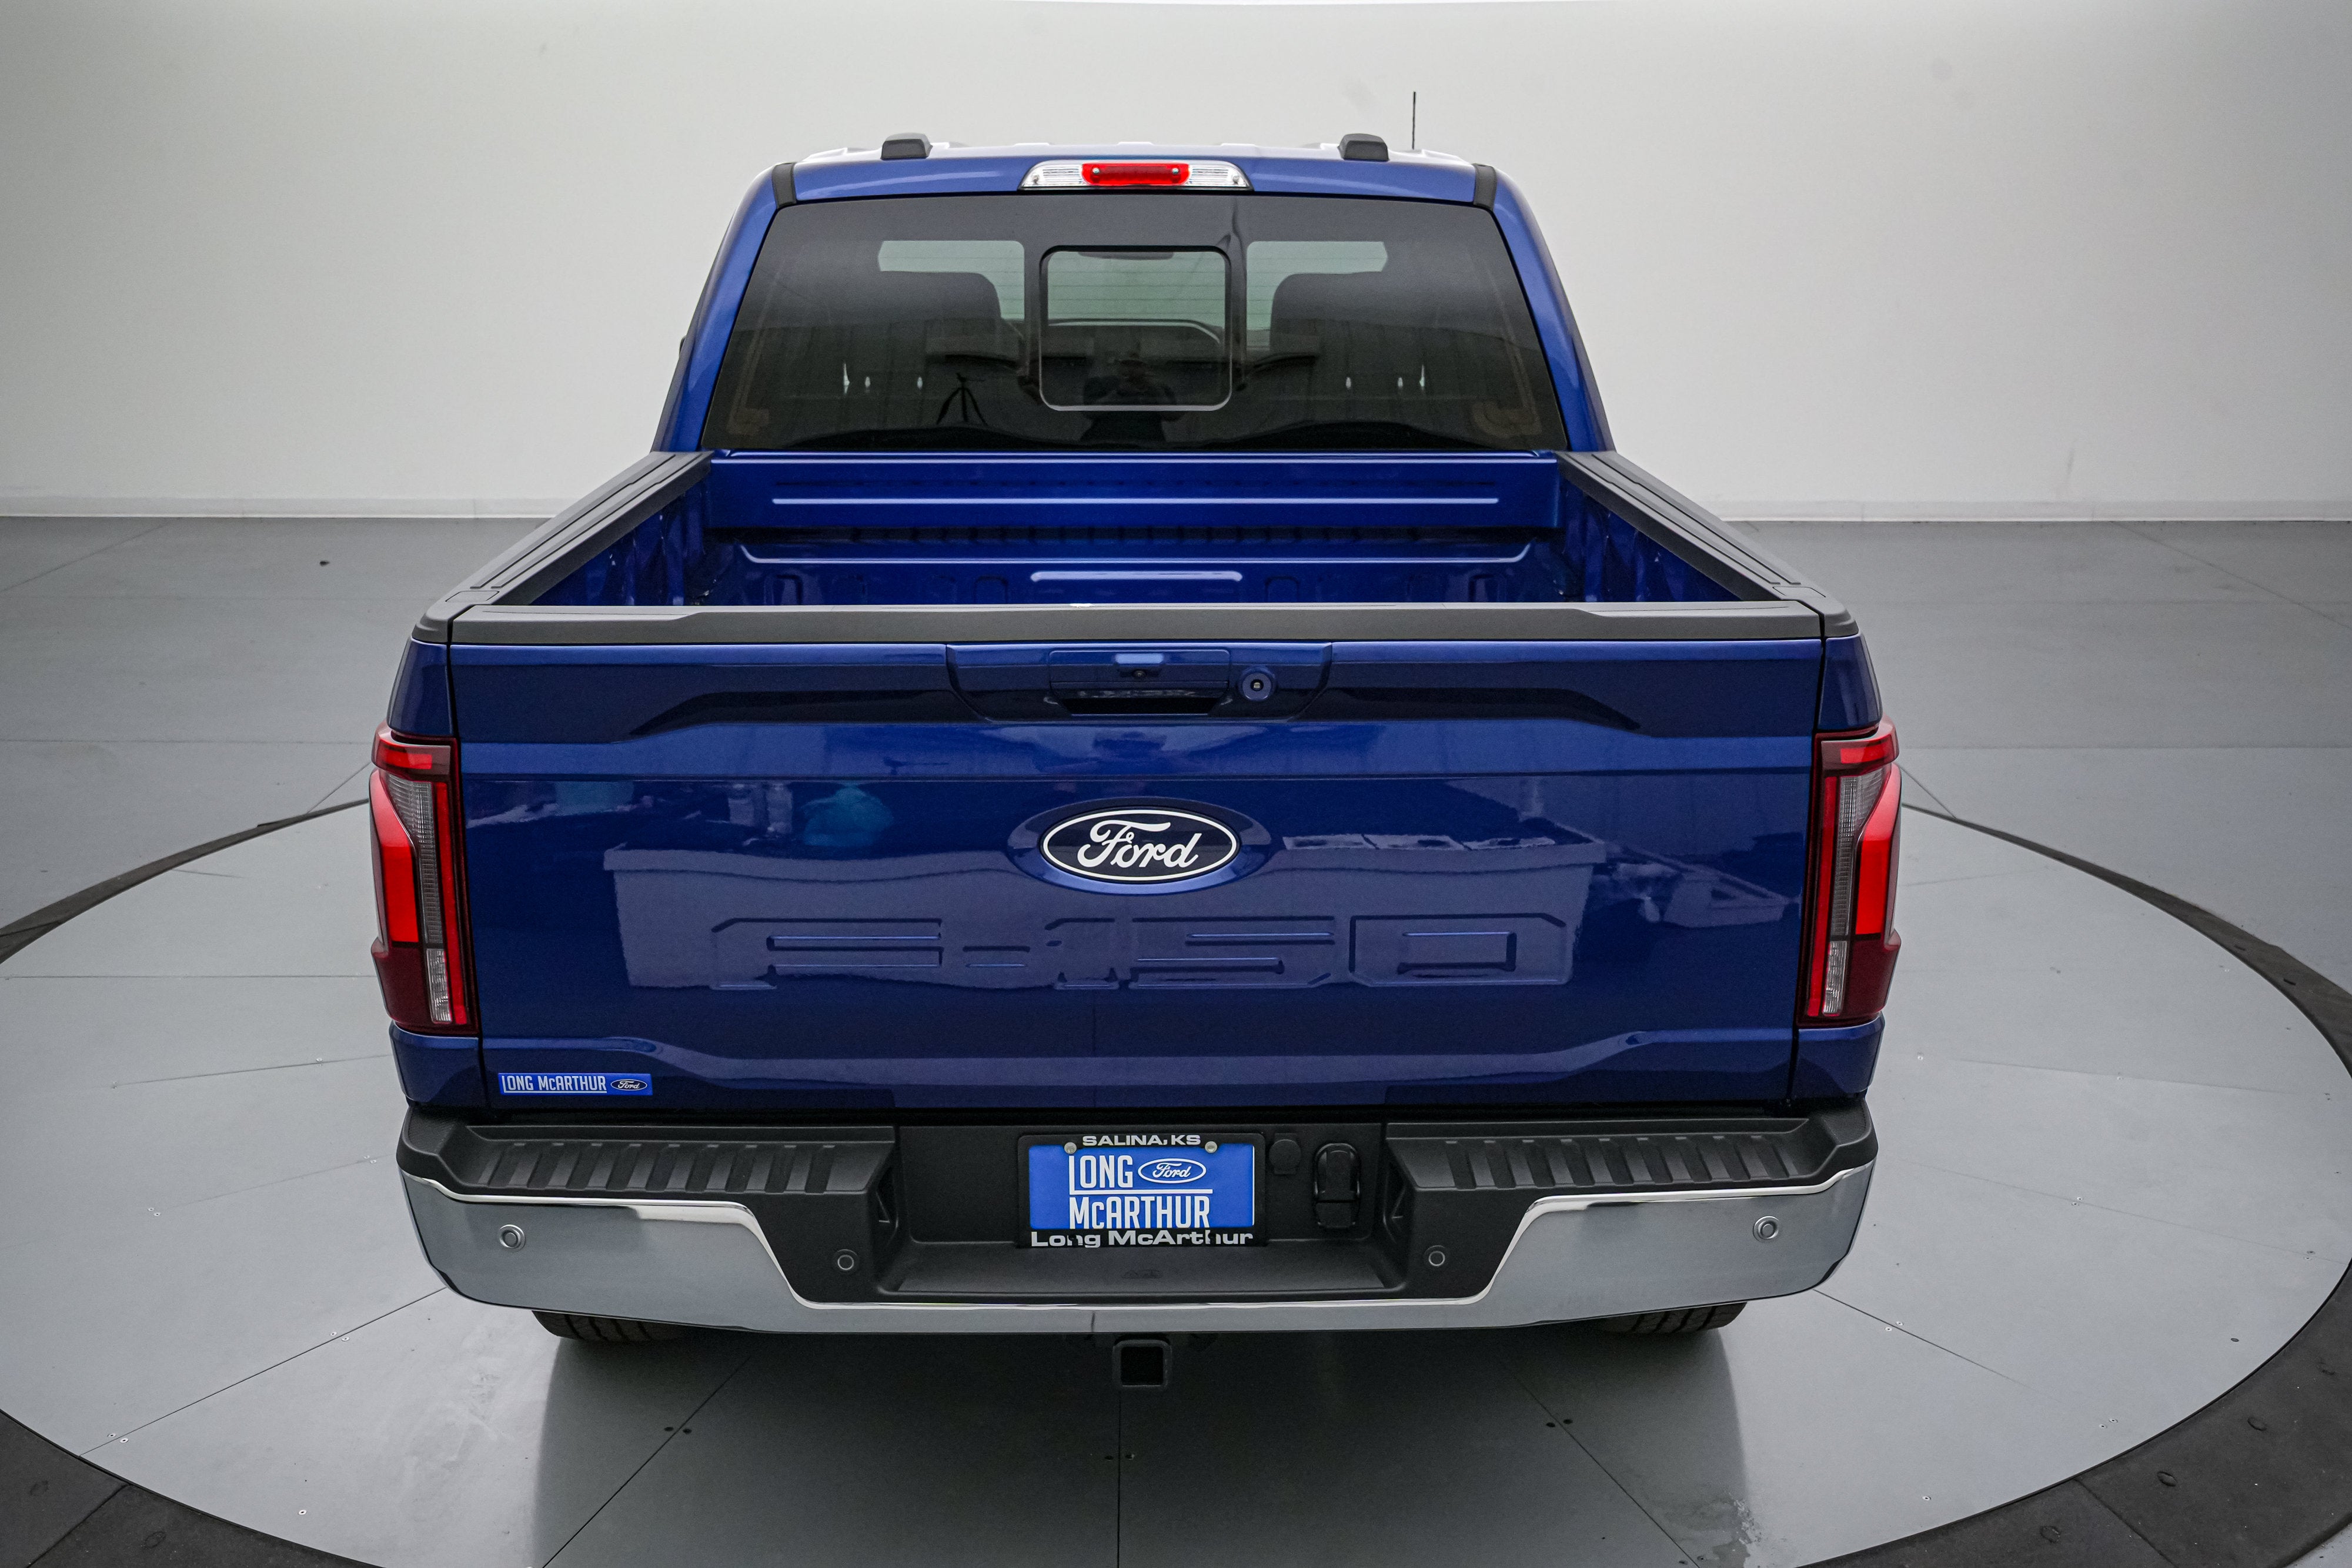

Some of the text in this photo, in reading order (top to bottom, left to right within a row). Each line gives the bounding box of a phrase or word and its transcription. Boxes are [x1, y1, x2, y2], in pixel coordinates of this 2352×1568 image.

[1077, 820, 1202, 867] Ford
[710, 913, 1573, 990] F-150
[502, 1075, 640, 1093] LONG McARTHUR Ford
[1083, 1135, 1201, 1146] SALINA, KS
[1069, 1155, 1191, 1195] LONG Ford
[1069, 1196, 1210, 1229] McARTHUR
[1031, 1230, 1253, 1248] Long McArthur
